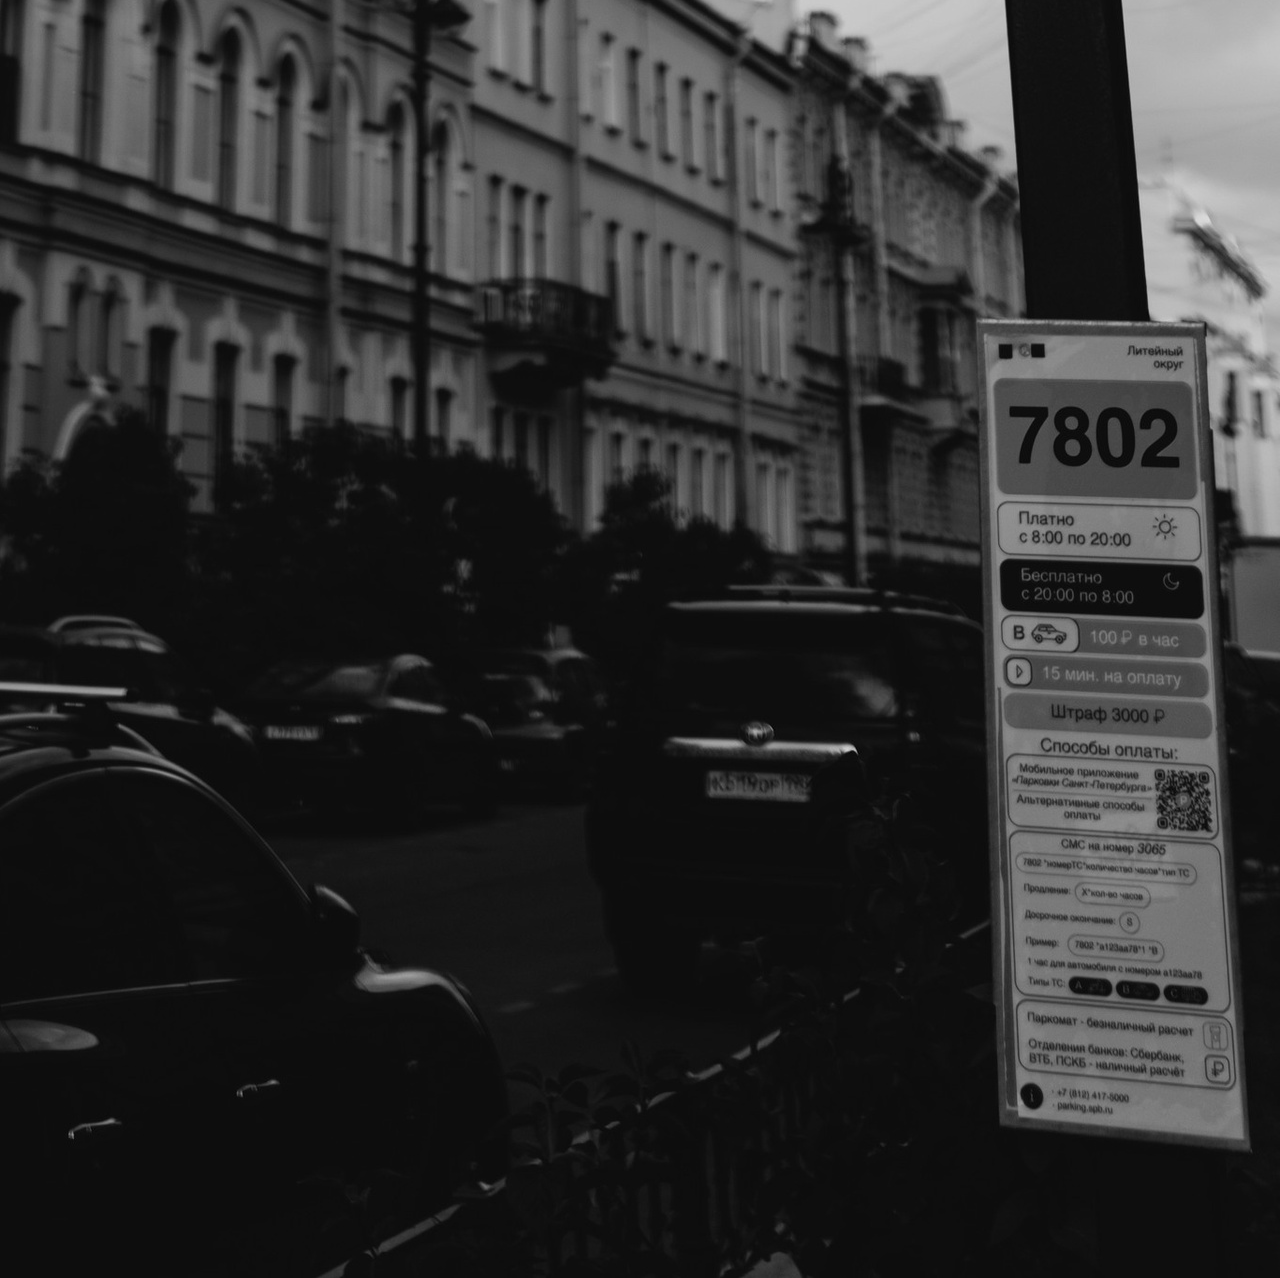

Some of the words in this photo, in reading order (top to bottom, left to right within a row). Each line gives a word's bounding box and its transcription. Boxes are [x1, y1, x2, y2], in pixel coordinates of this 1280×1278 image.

[1127, 345, 1183, 356] Литейный
[1153, 359, 1184, 370] округ
[1009, 405, 1180, 468] 7802
[1019, 511, 1074, 526] Платно
[1019, 533, 1027, 543] с
[1031, 531, 1063, 544] 8:00
[1068, 534, 1086, 545] по
[1090, 531, 1131, 546] 20:00
[1021, 568, 1102, 584] Бесплатно
[1021, 590, 1029, 599] с
[1034, 587, 1074, 601] 20:00
[1080, 592, 1097, 602] по
[1103, 590, 1134, 604] 8:00
[1091, 630, 1117, 645] 100
[1152, 636, 1179, 647] час
[1043, 666, 1060, 680] 15
[1065, 670, 1099, 682] мин.
[1105, 673, 1122, 683] на
[1128, 673, 1181, 690] оплату
[1051, 704, 1107, 723] Штраф
[1112, 708, 1148, 723] 3000
[1040, 737, 1109, 756] Способы
[1115, 745, 1178, 760] оплаты:
[1020, 763, 1074, 776] Мобильное
[1077, 767, 1138, 780] приложение
[1017, 795, 1100, 808] Альтернативные
[1103, 801, 1144, 812] способы
[1064, 810, 1100, 820] оплаты
[1061, 839, 1085, 850] СМС
[1088, 842, 1100, 851] на
[1103, 843, 1134, 854] номер
[1137, 843, 1166, 855] 3065
[1023, 858, 1042, 867] 7802
[1025, 910, 1068, 922] Досрочное
[1027, 1012, 1077, 1026] Паркомат
[1087, 1018, 1155, 1033] безналичный
[1028, 1039, 1086, 1053] Отделения
[1088, 1045, 1128, 1057] банков:
[1096, 1061, 1147, 1074] наличный
